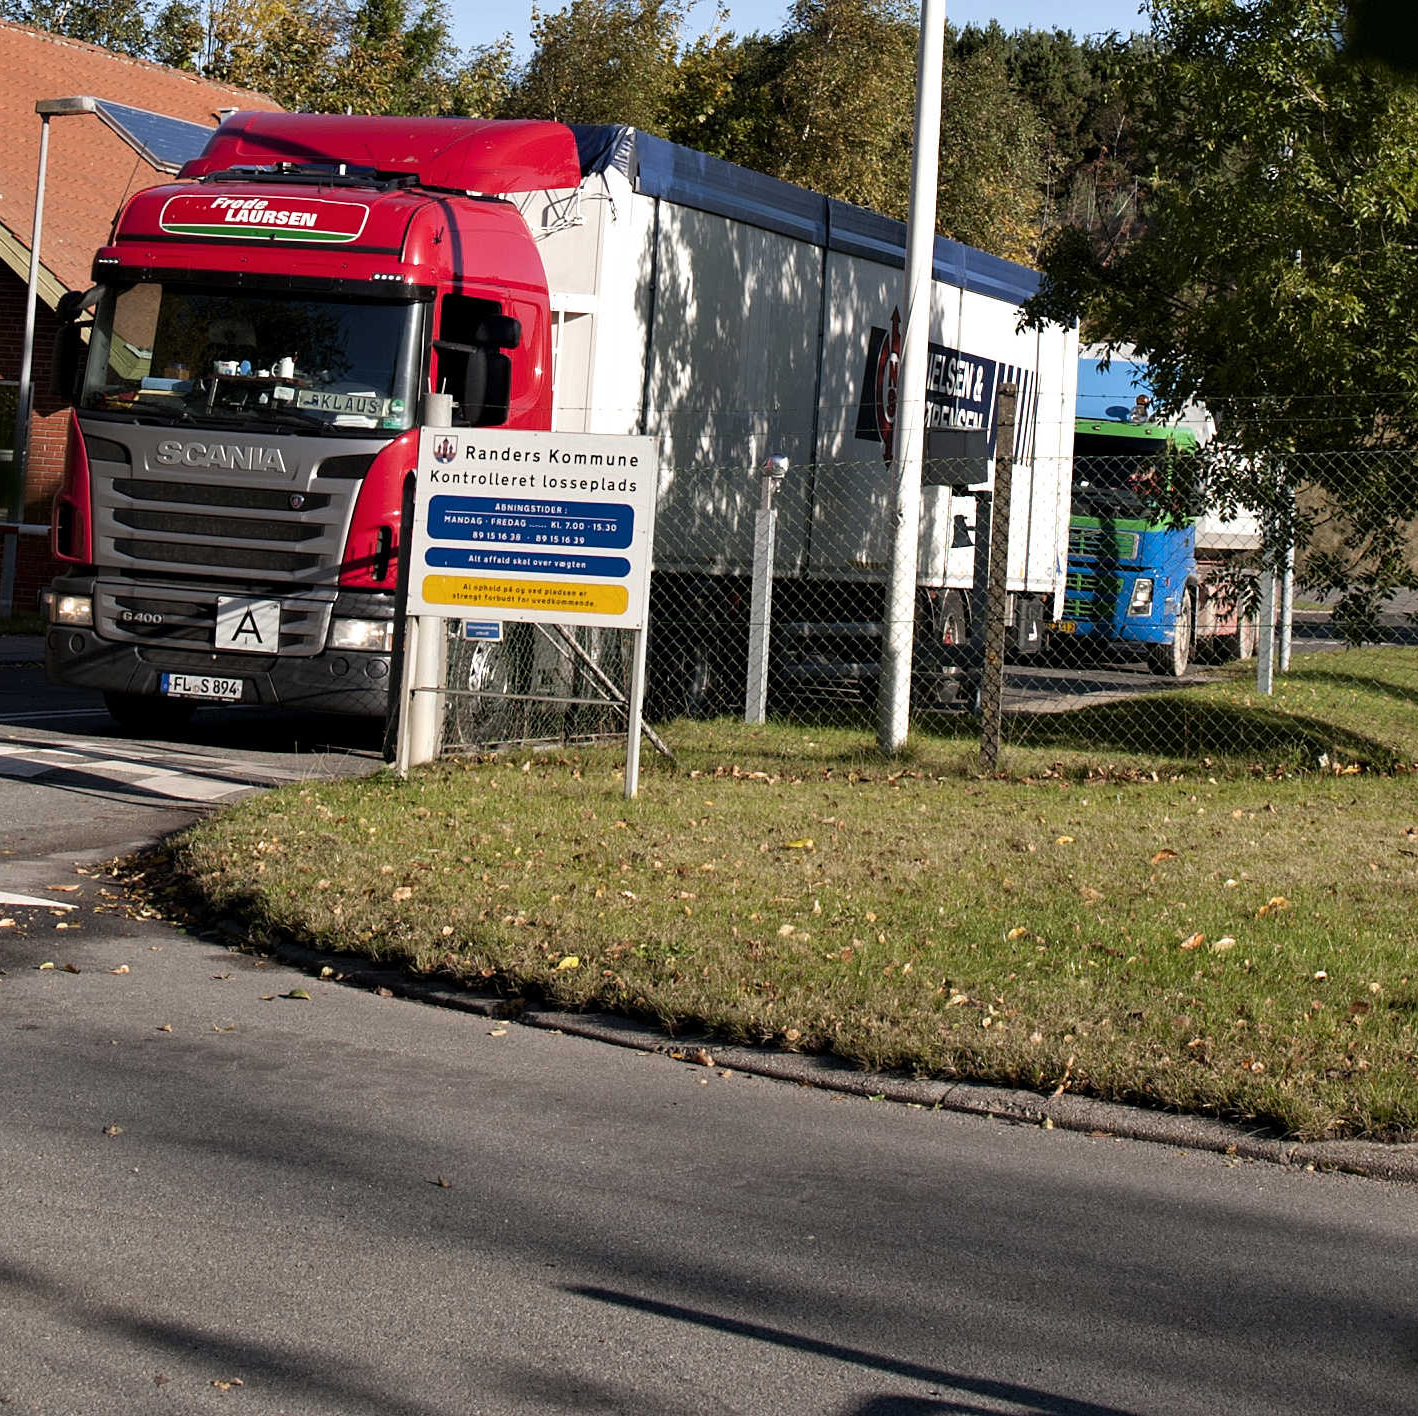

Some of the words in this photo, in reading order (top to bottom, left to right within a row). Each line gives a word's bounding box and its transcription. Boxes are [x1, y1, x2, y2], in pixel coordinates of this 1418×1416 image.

[210, 197, 269, 210] Frode
[224, 209, 318, 227] LAURSEN
[926, 353, 975, 400] IELSEN
[156, 440, 286, 473] SCANIA
[466, 445, 541, 463] Randers
[549, 449, 639, 467] Kommune
[430, 469, 535, 487] Kontrolleret
[543, 474, 637, 493] losseplads
[444, 515, 483, 525] MANDAG
[491, 517, 527, 527] FREDAG
[468, 554, 481, 563] Alt
[231, 607, 263, 644] A
[173, 676, 191, 692] FL
[200, 678, 210, 694] S
[213, 679, 237, 696] 894
